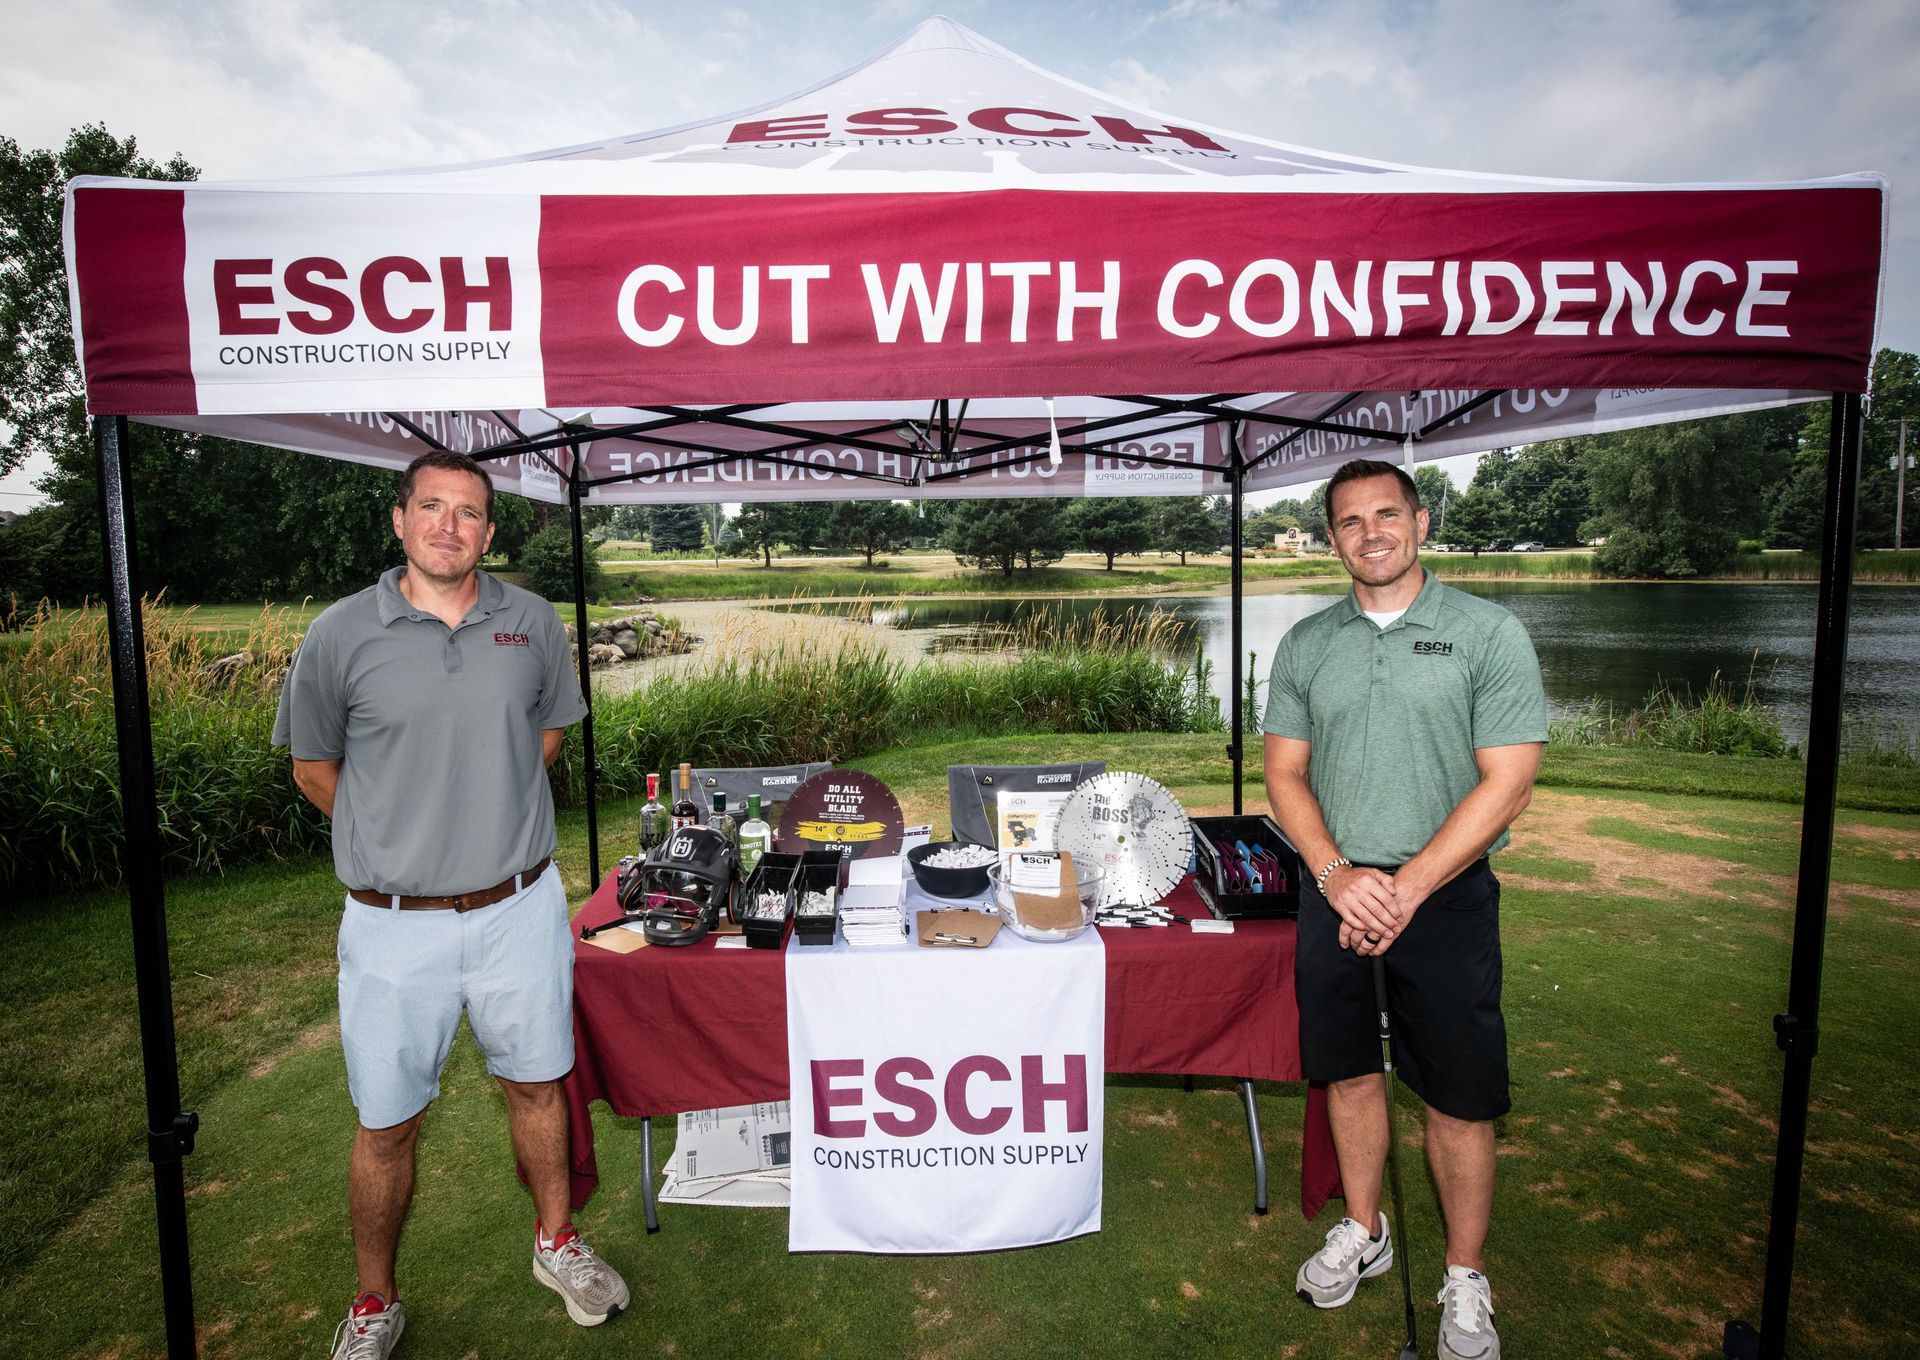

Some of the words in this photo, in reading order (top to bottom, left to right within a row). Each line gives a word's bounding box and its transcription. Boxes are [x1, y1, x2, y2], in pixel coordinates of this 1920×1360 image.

[727, 107, 1231, 152] ESCH
[721, 137, 1073, 151] CONSTRUCTION
[1086, 142, 1240, 161] SUPPLY
[214, 256, 512, 336] ESCH
[616, 264, 831, 347] CUT
[860, 260, 1121, 343] WITH
[1156, 258, 1799, 339] CONFIDENCE
[219, 343, 413, 366] CONSTRUCTION
[422, 341, 511, 362] SUPPLY
[494, 633, 529, 644] ESCH
[1413, 641, 1453, 653] ESCH
[823, 794, 865, 804] UTILITY
[828, 784, 840, 794] DO
[842, 785, 861, 794] ALL
[827, 804, 858, 814] BLADE
[1092, 805, 1129, 825] BOSS
[824, 843, 853, 854] ESCH
[810, 1055, 1088, 1138] ESCH
[813, 1145, 995, 1170] CONSTRUCTION
[1003, 1142, 1089, 1165] SUPPLY
